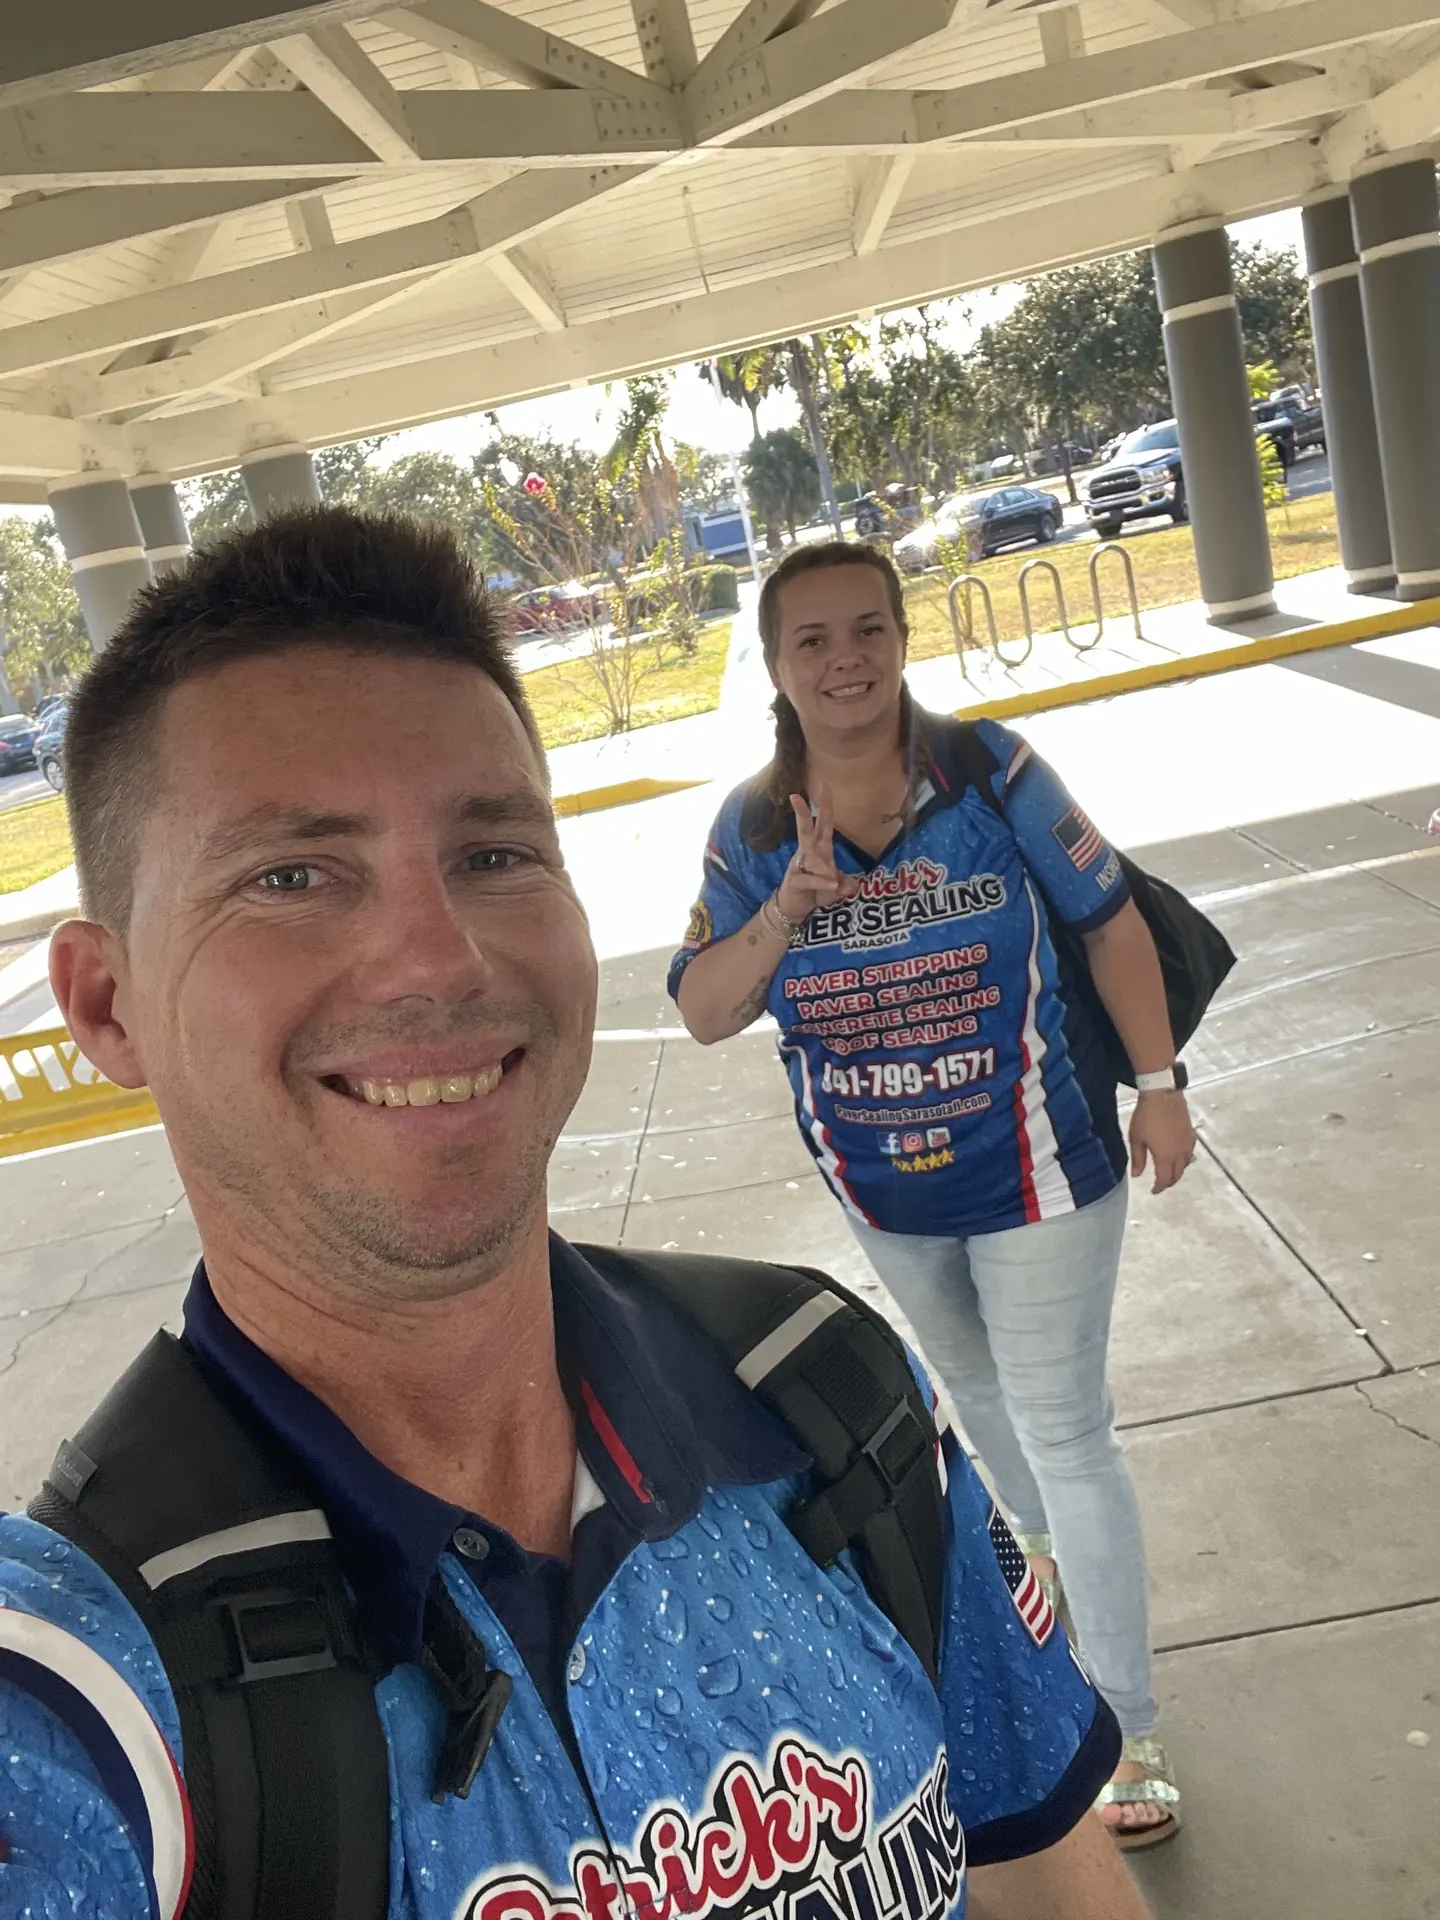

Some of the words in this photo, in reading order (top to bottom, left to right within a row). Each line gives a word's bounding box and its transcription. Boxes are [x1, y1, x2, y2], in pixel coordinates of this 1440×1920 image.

[860, 876, 1004, 937] SEALING
[843, 932, 909, 950] SARASOTA
[785, 969, 859, 998] PAVER
[862, 944, 988, 986] STRIPPING
[798, 992, 875, 1019] PAVER
[877, 971, 978, 1006] SEALING
[905, 986, 1000, 1022] SEALING
[882, 1016, 978, 1048] SEALING
